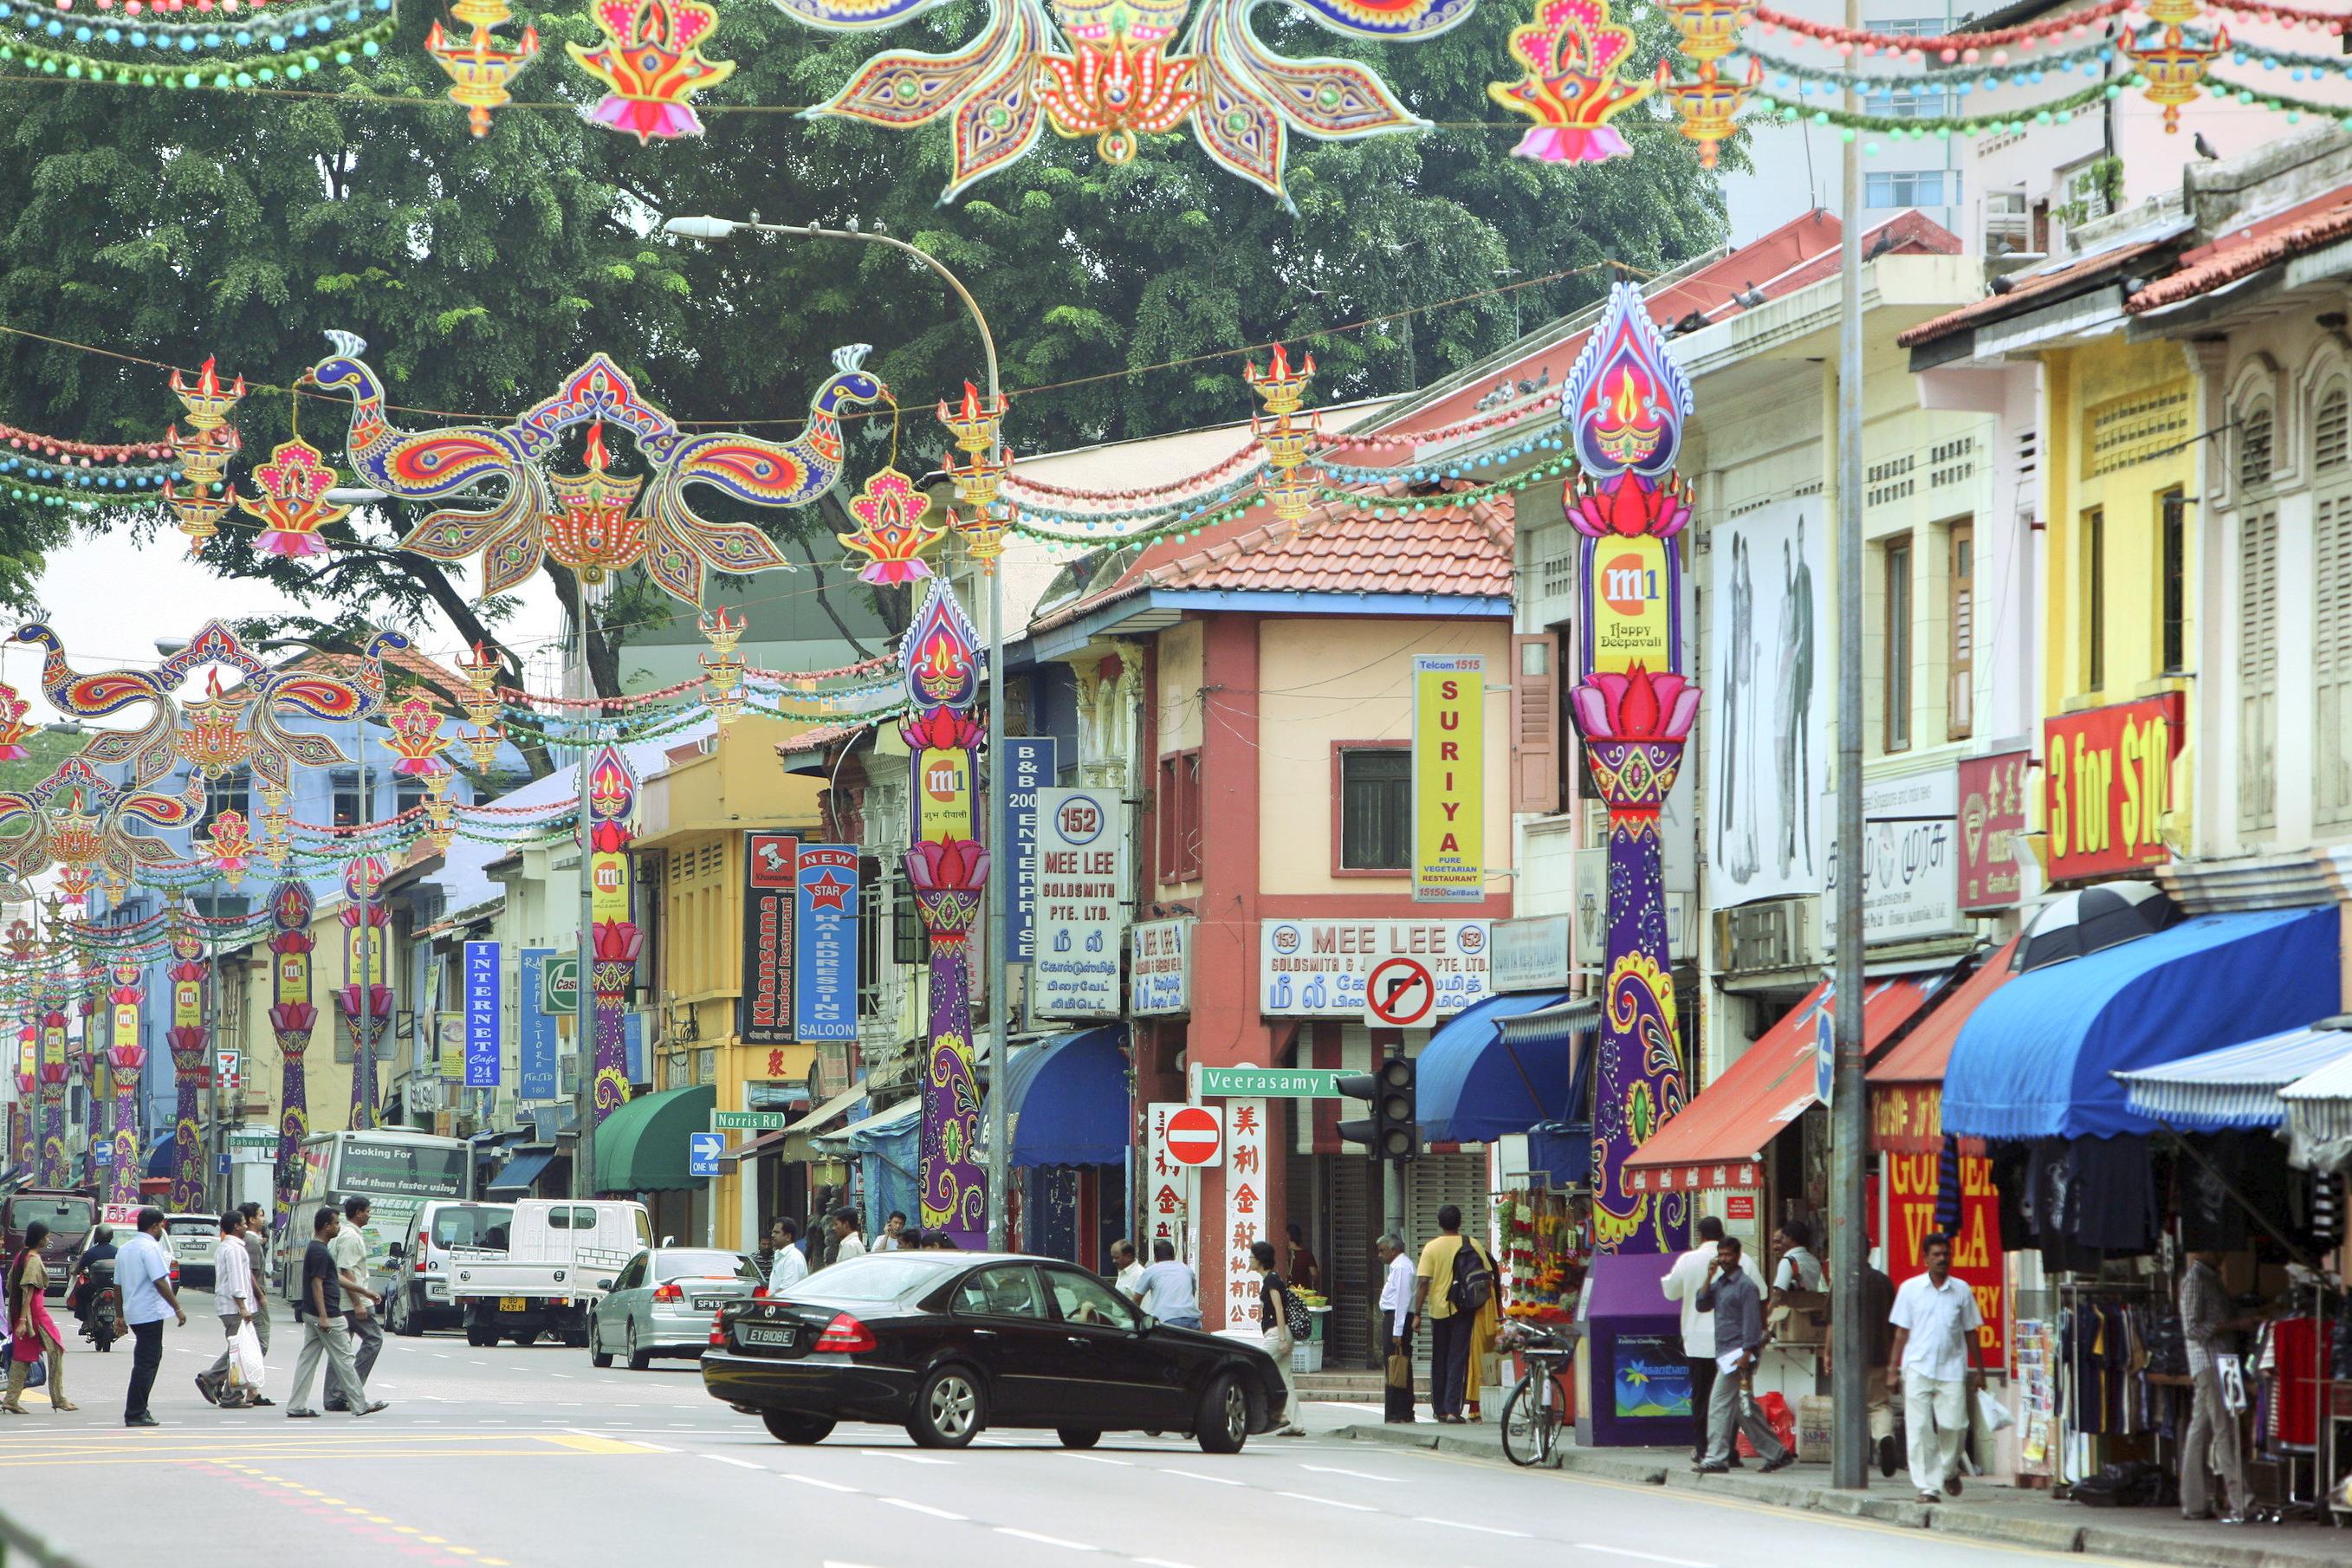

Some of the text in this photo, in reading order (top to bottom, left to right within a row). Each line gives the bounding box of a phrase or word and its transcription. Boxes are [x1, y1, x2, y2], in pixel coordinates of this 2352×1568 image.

[1607, 569, 1660, 600] m1
[1610, 623, 1650, 638] Happy
[1601, 636, 1662, 648] Deepavali
[1421, 659, 1481, 670] Telcom 1515
[1440, 680, 1459, 852] SURIYA
[930, 770, 965, 792] m1
[2051, 734, 2068, 859] 3
[2075, 731, 2112, 855] for
[2121, 713, 2167, 859] $10
[1009, 794, 1036, 807] 200
[1061, 807, 1096, 833] 152
[805, 855, 852, 865] NEW
[1044, 852, 1114, 874] MEE LEE
[597, 869, 625, 885] m1
[814, 885, 839, 897] STAR
[1043, 883, 1115, 898] GOLDSMITH
[1050, 905, 1111, 920] PTE. LTD.
[1276, 925, 1481, 953] 152 MEE LEE 152
[753, 896, 777, 1027] Khansama
[778, 897, 793, 1027] Tandoori Restaurant
[814, 915, 840, 1020] HAIRDRESSING
[1272, 957, 1489, 972] GOLDSMITH & PTE. LTD.
[284, 965, 304, 977] m1
[180, 992, 197, 1002] m1
[473, 945, 492, 1052] INTERNET
[800, 1024, 854, 1036] SALOON
[469, 1054, 496, 1065] Cafe
[474, 1066, 492, 1078] 24
[1208, 1072, 1319, 1092] Veerasamy
[719, 1114, 777, 1127] Norris Rd
[230, 1137, 278, 1146] Baboo La
[348, 1146, 411, 1159] Looking For
[693, 1163, 718, 1171] ONE WA
[346, 1176, 457, 1194] Find them faster using
[1230, 1305, 1262, 1323] 公司
